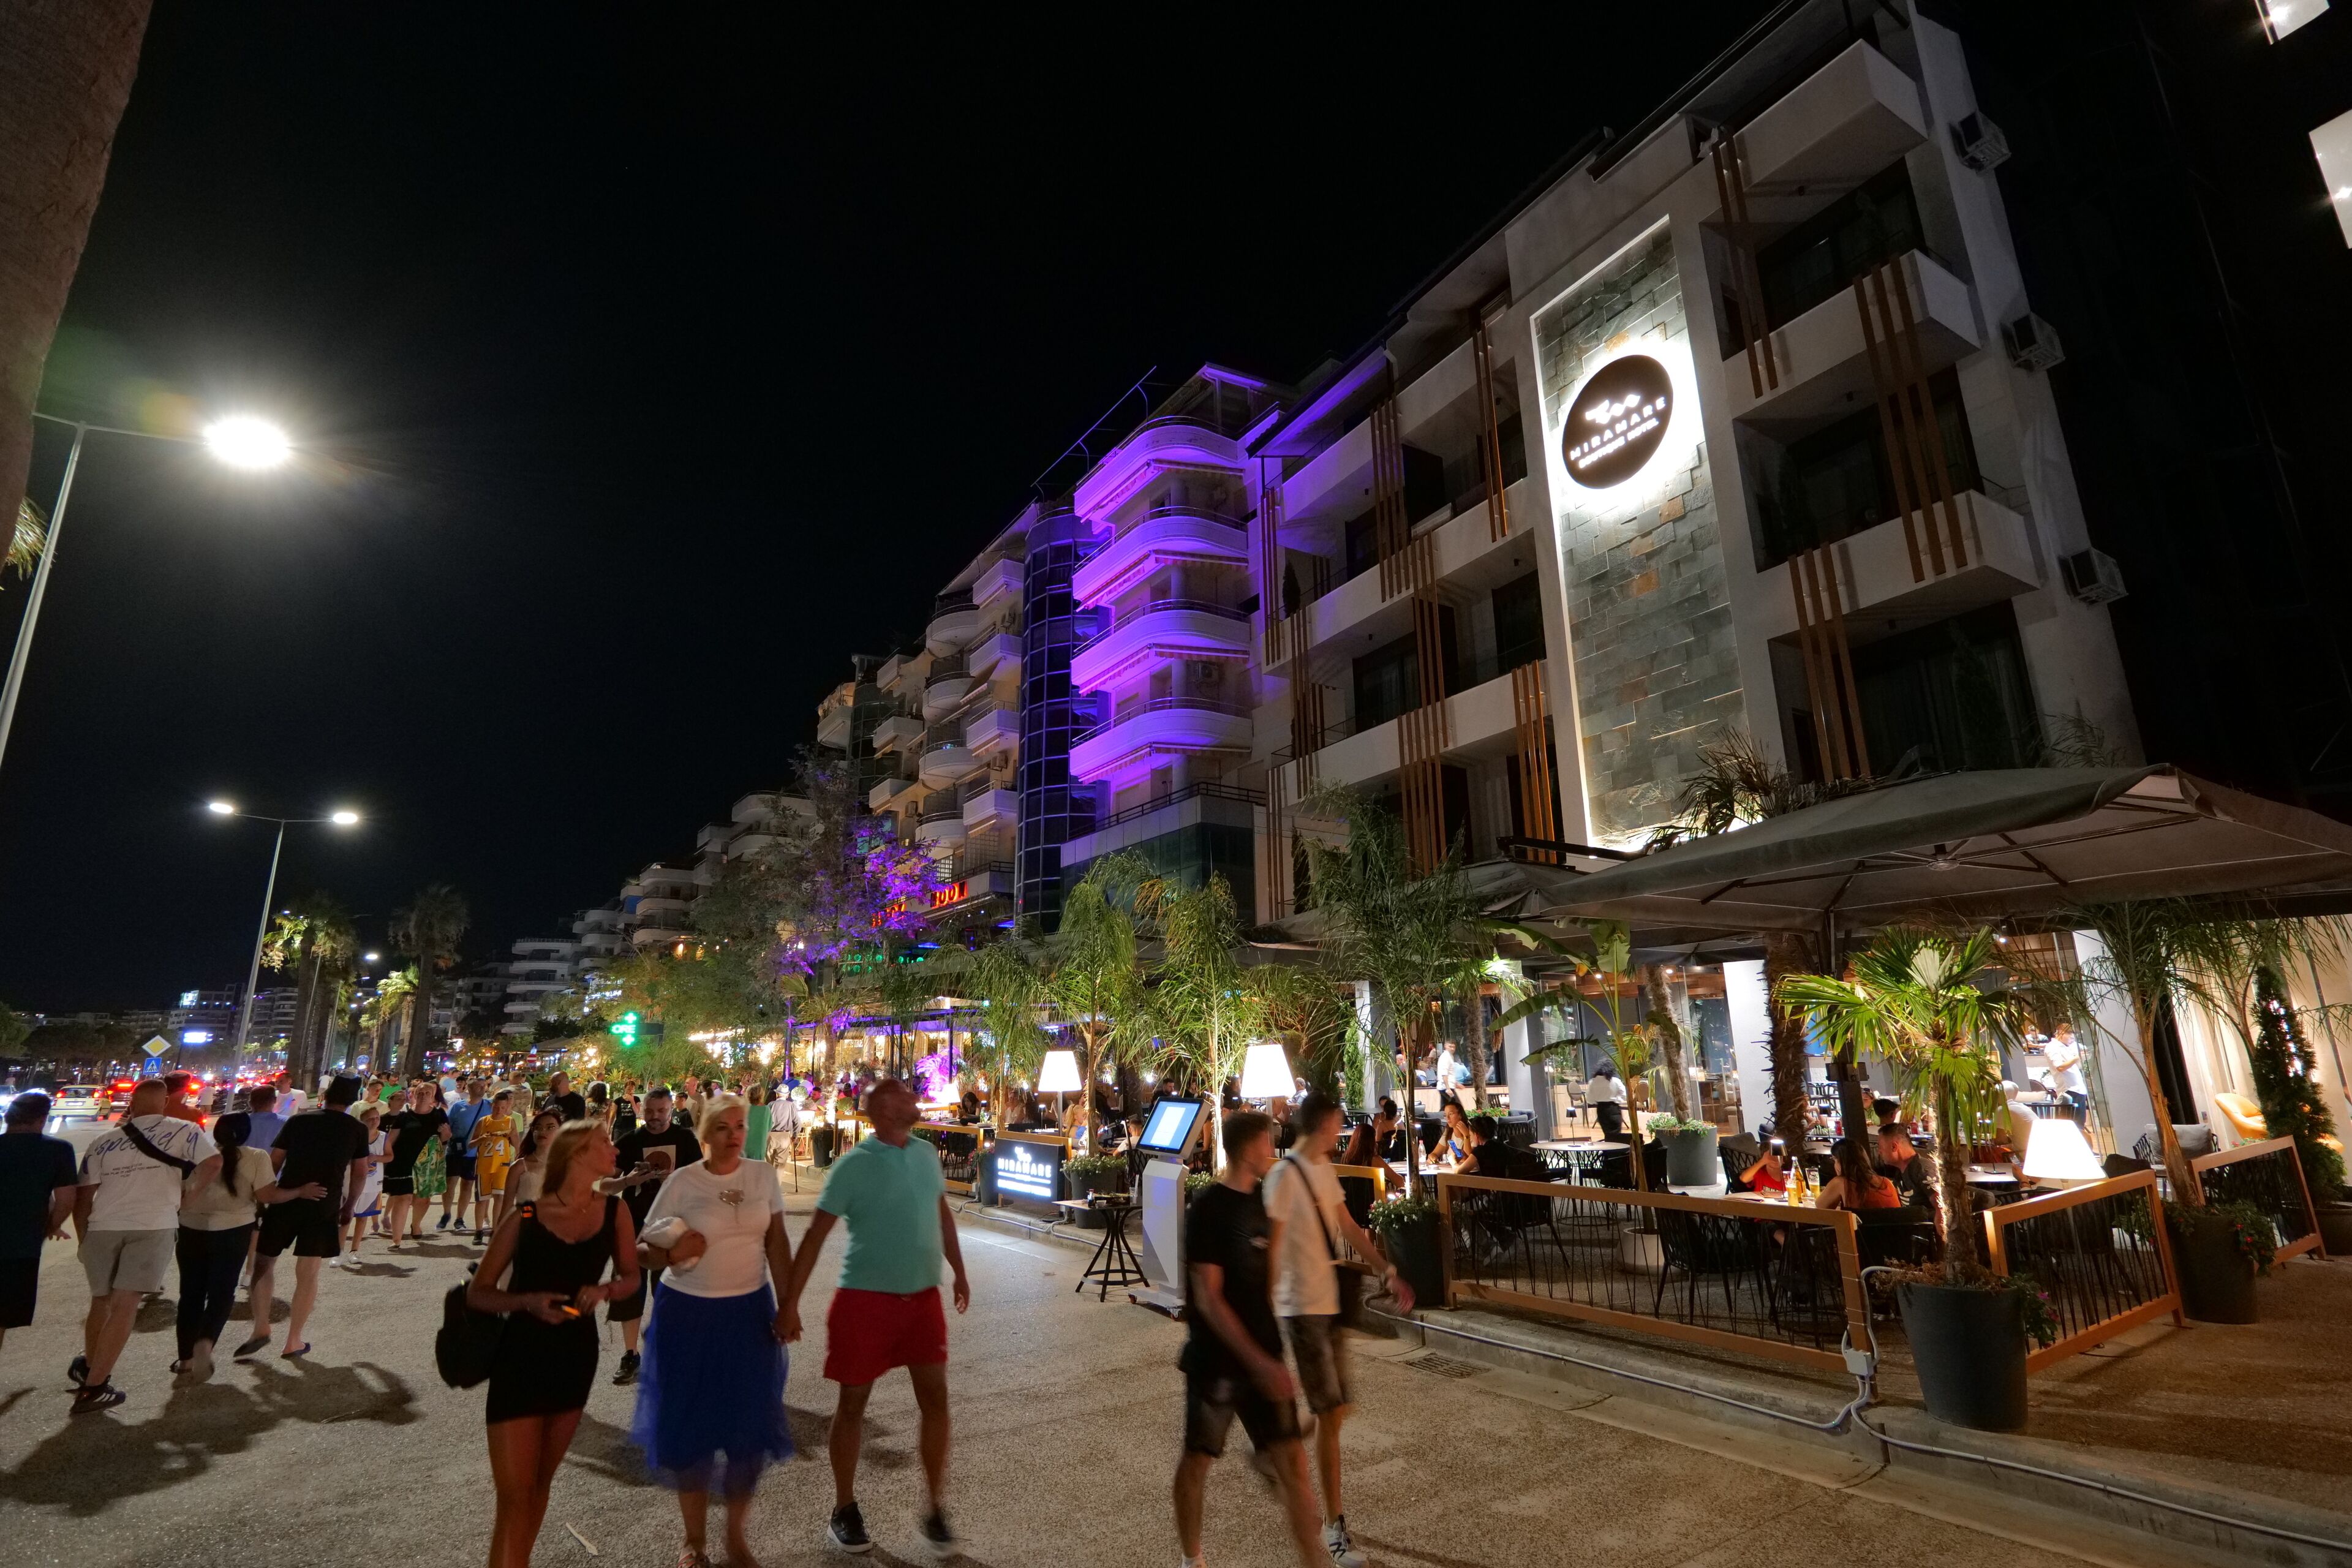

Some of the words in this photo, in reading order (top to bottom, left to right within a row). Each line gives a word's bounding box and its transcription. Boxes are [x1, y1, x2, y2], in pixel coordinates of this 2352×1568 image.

[1570, 397, 1665, 460] MIRAMARE
[483, 1140, 504, 1156] 24
[998, 1158, 1052, 1178] MIRAMARE
